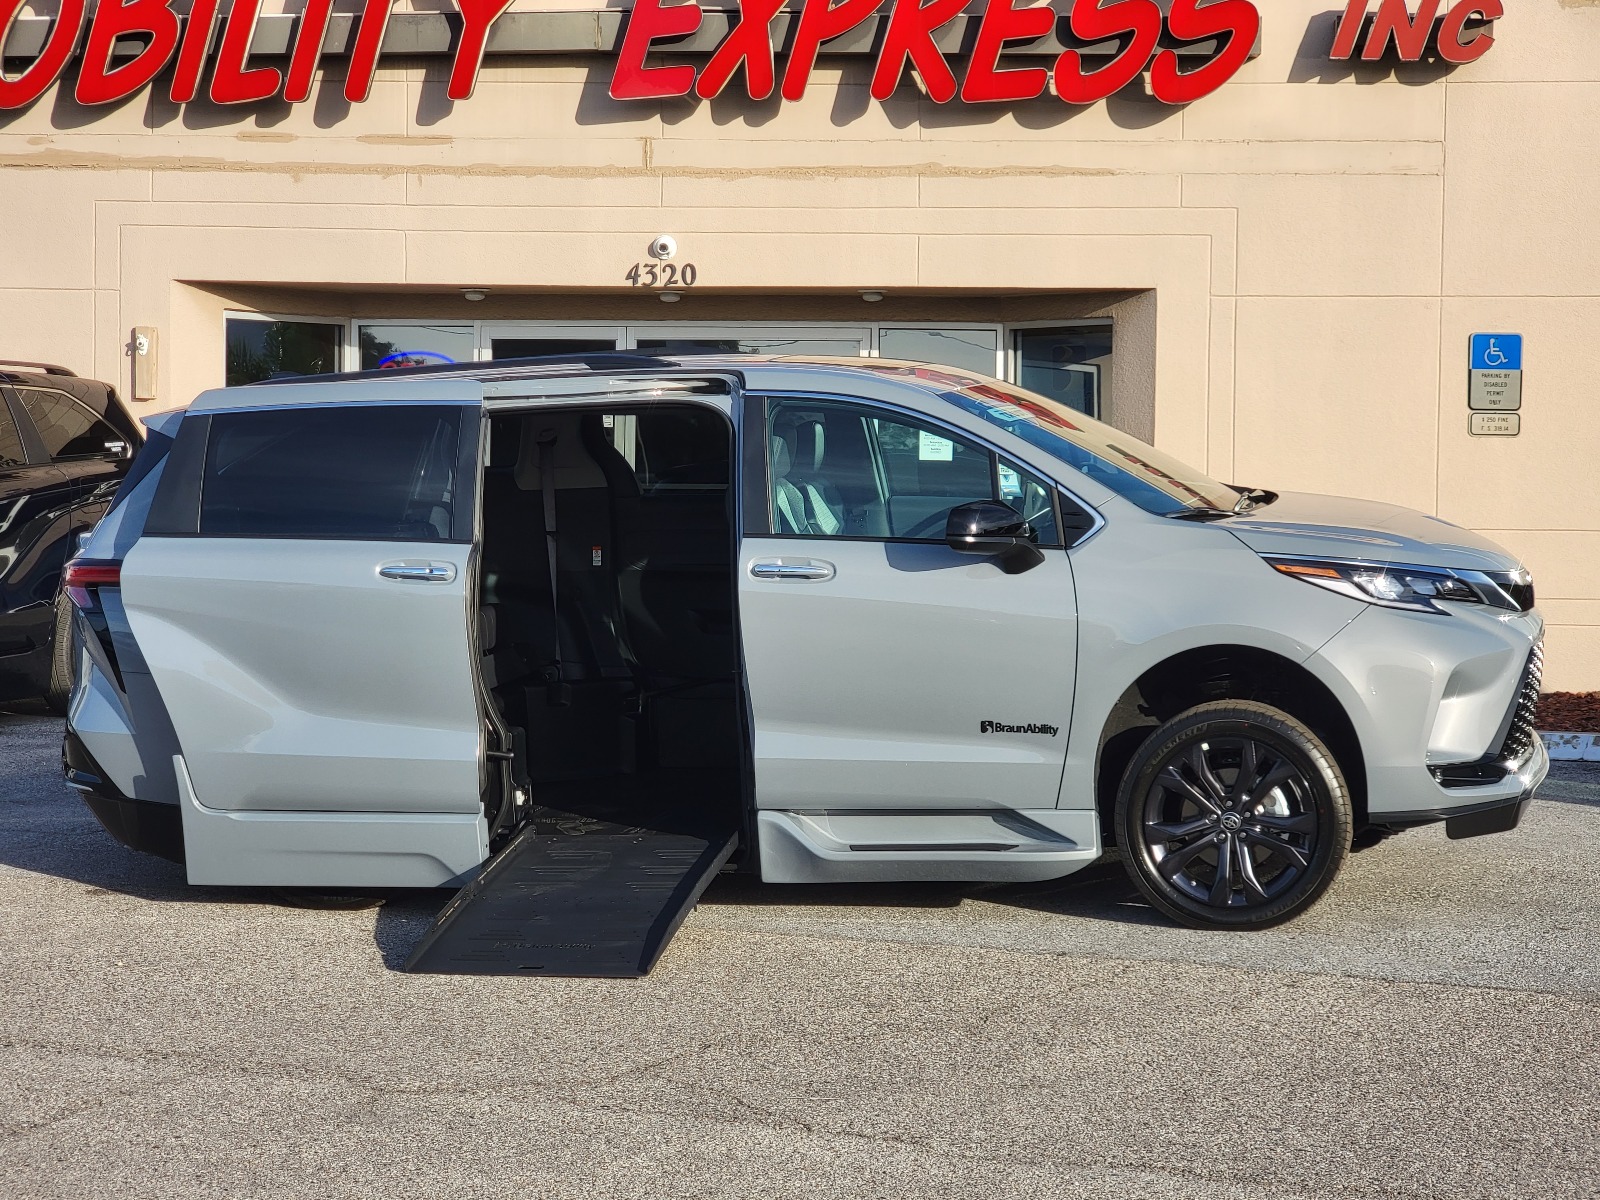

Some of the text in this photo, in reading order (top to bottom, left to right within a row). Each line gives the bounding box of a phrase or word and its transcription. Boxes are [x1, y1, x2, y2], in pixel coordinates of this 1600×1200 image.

[609, 0, 1260, 104] EXPRESS
[625, 262, 697, 287] 4320
[995, 722, 1059, 737] BraunAbility
